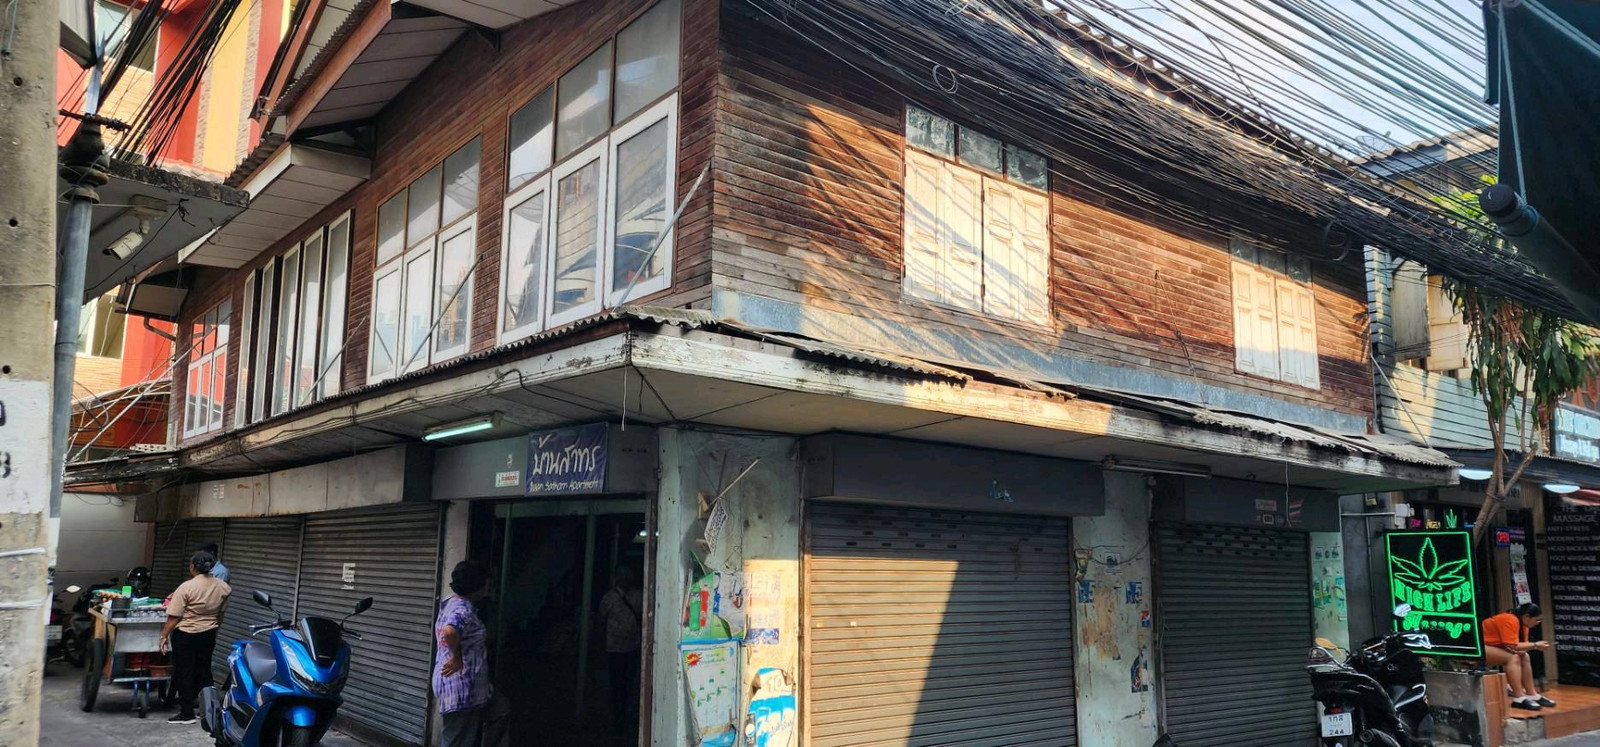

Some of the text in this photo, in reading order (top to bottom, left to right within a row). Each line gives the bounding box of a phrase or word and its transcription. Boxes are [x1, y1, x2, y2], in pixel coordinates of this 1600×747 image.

[532, 434, 601, 476] บ้านสาทร
[1394, 579, 1472, 611] HIGH LIFE
